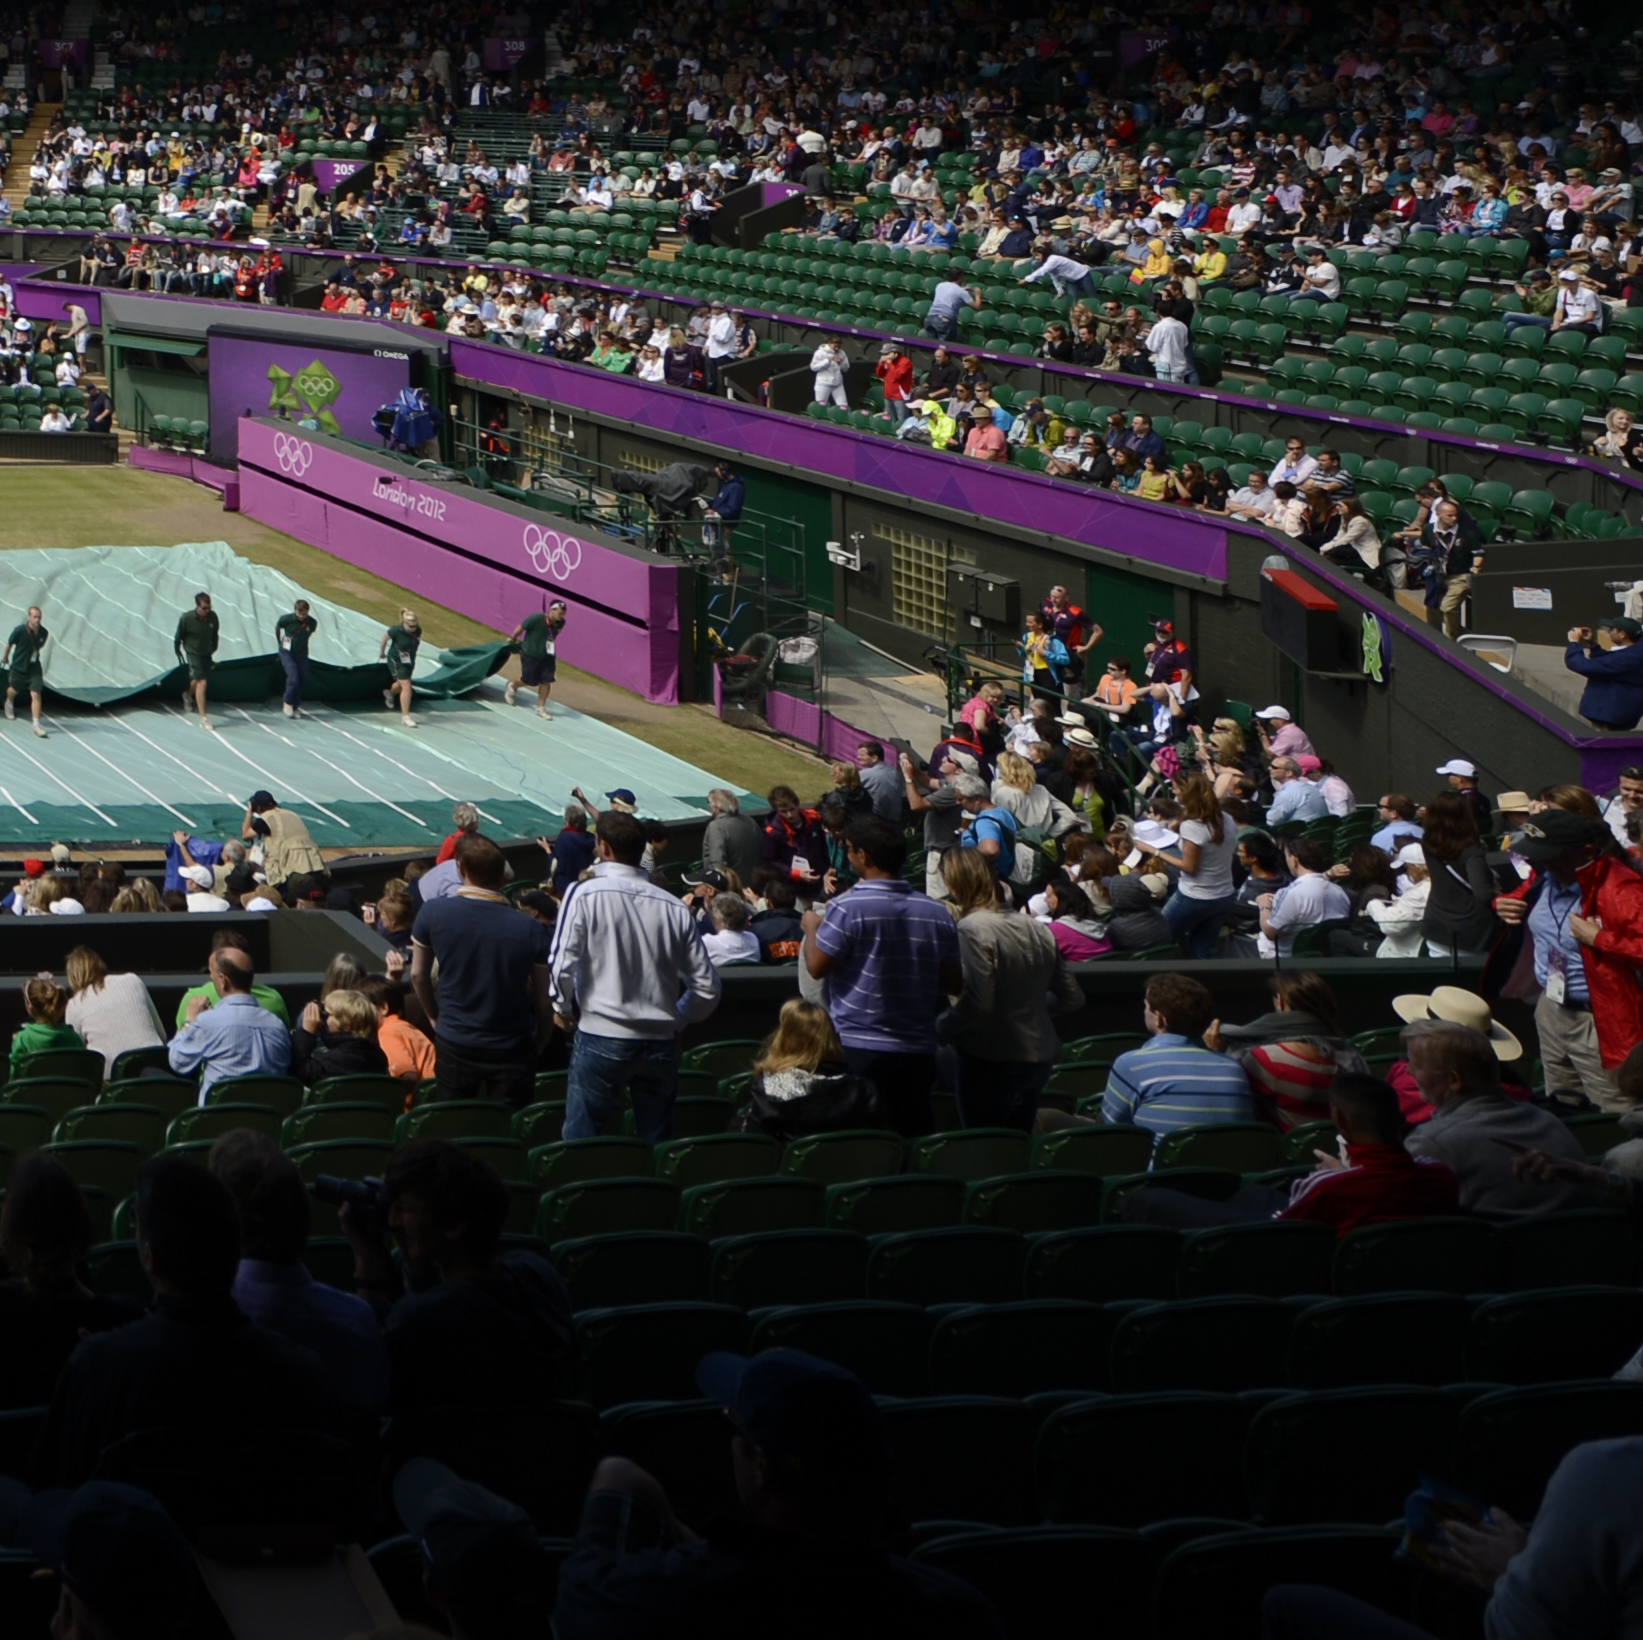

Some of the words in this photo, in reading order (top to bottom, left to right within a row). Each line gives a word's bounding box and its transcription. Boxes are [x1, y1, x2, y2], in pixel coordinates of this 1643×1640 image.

[504, 41, 525, 51] 308
[333, 163, 355, 175] 205
[373, 476, 416, 510] London
[417, 493, 447, 522] 2012
